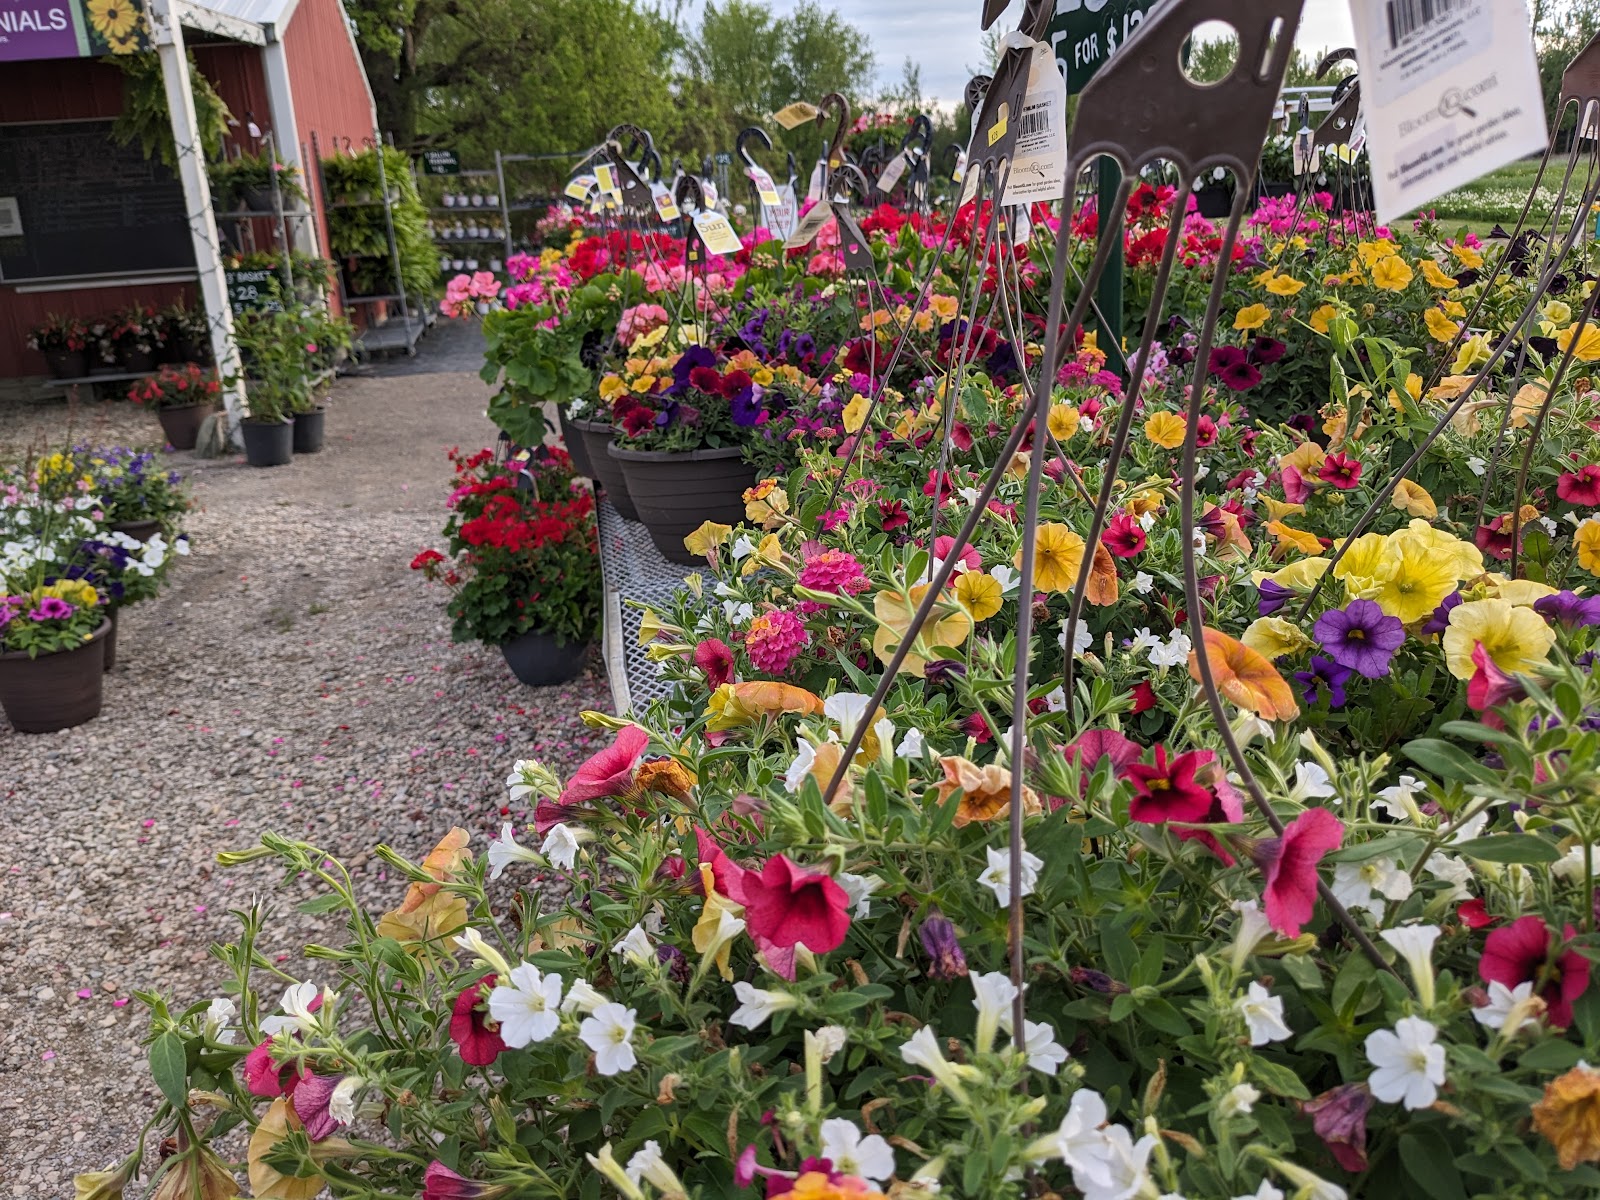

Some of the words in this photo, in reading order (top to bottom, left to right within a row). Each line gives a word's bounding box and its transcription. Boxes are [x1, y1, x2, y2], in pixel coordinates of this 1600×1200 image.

[0, 8, 67, 33] NIALS
[1075, 33, 1099, 69] FOR
[698, 222, 726, 233] Sun
